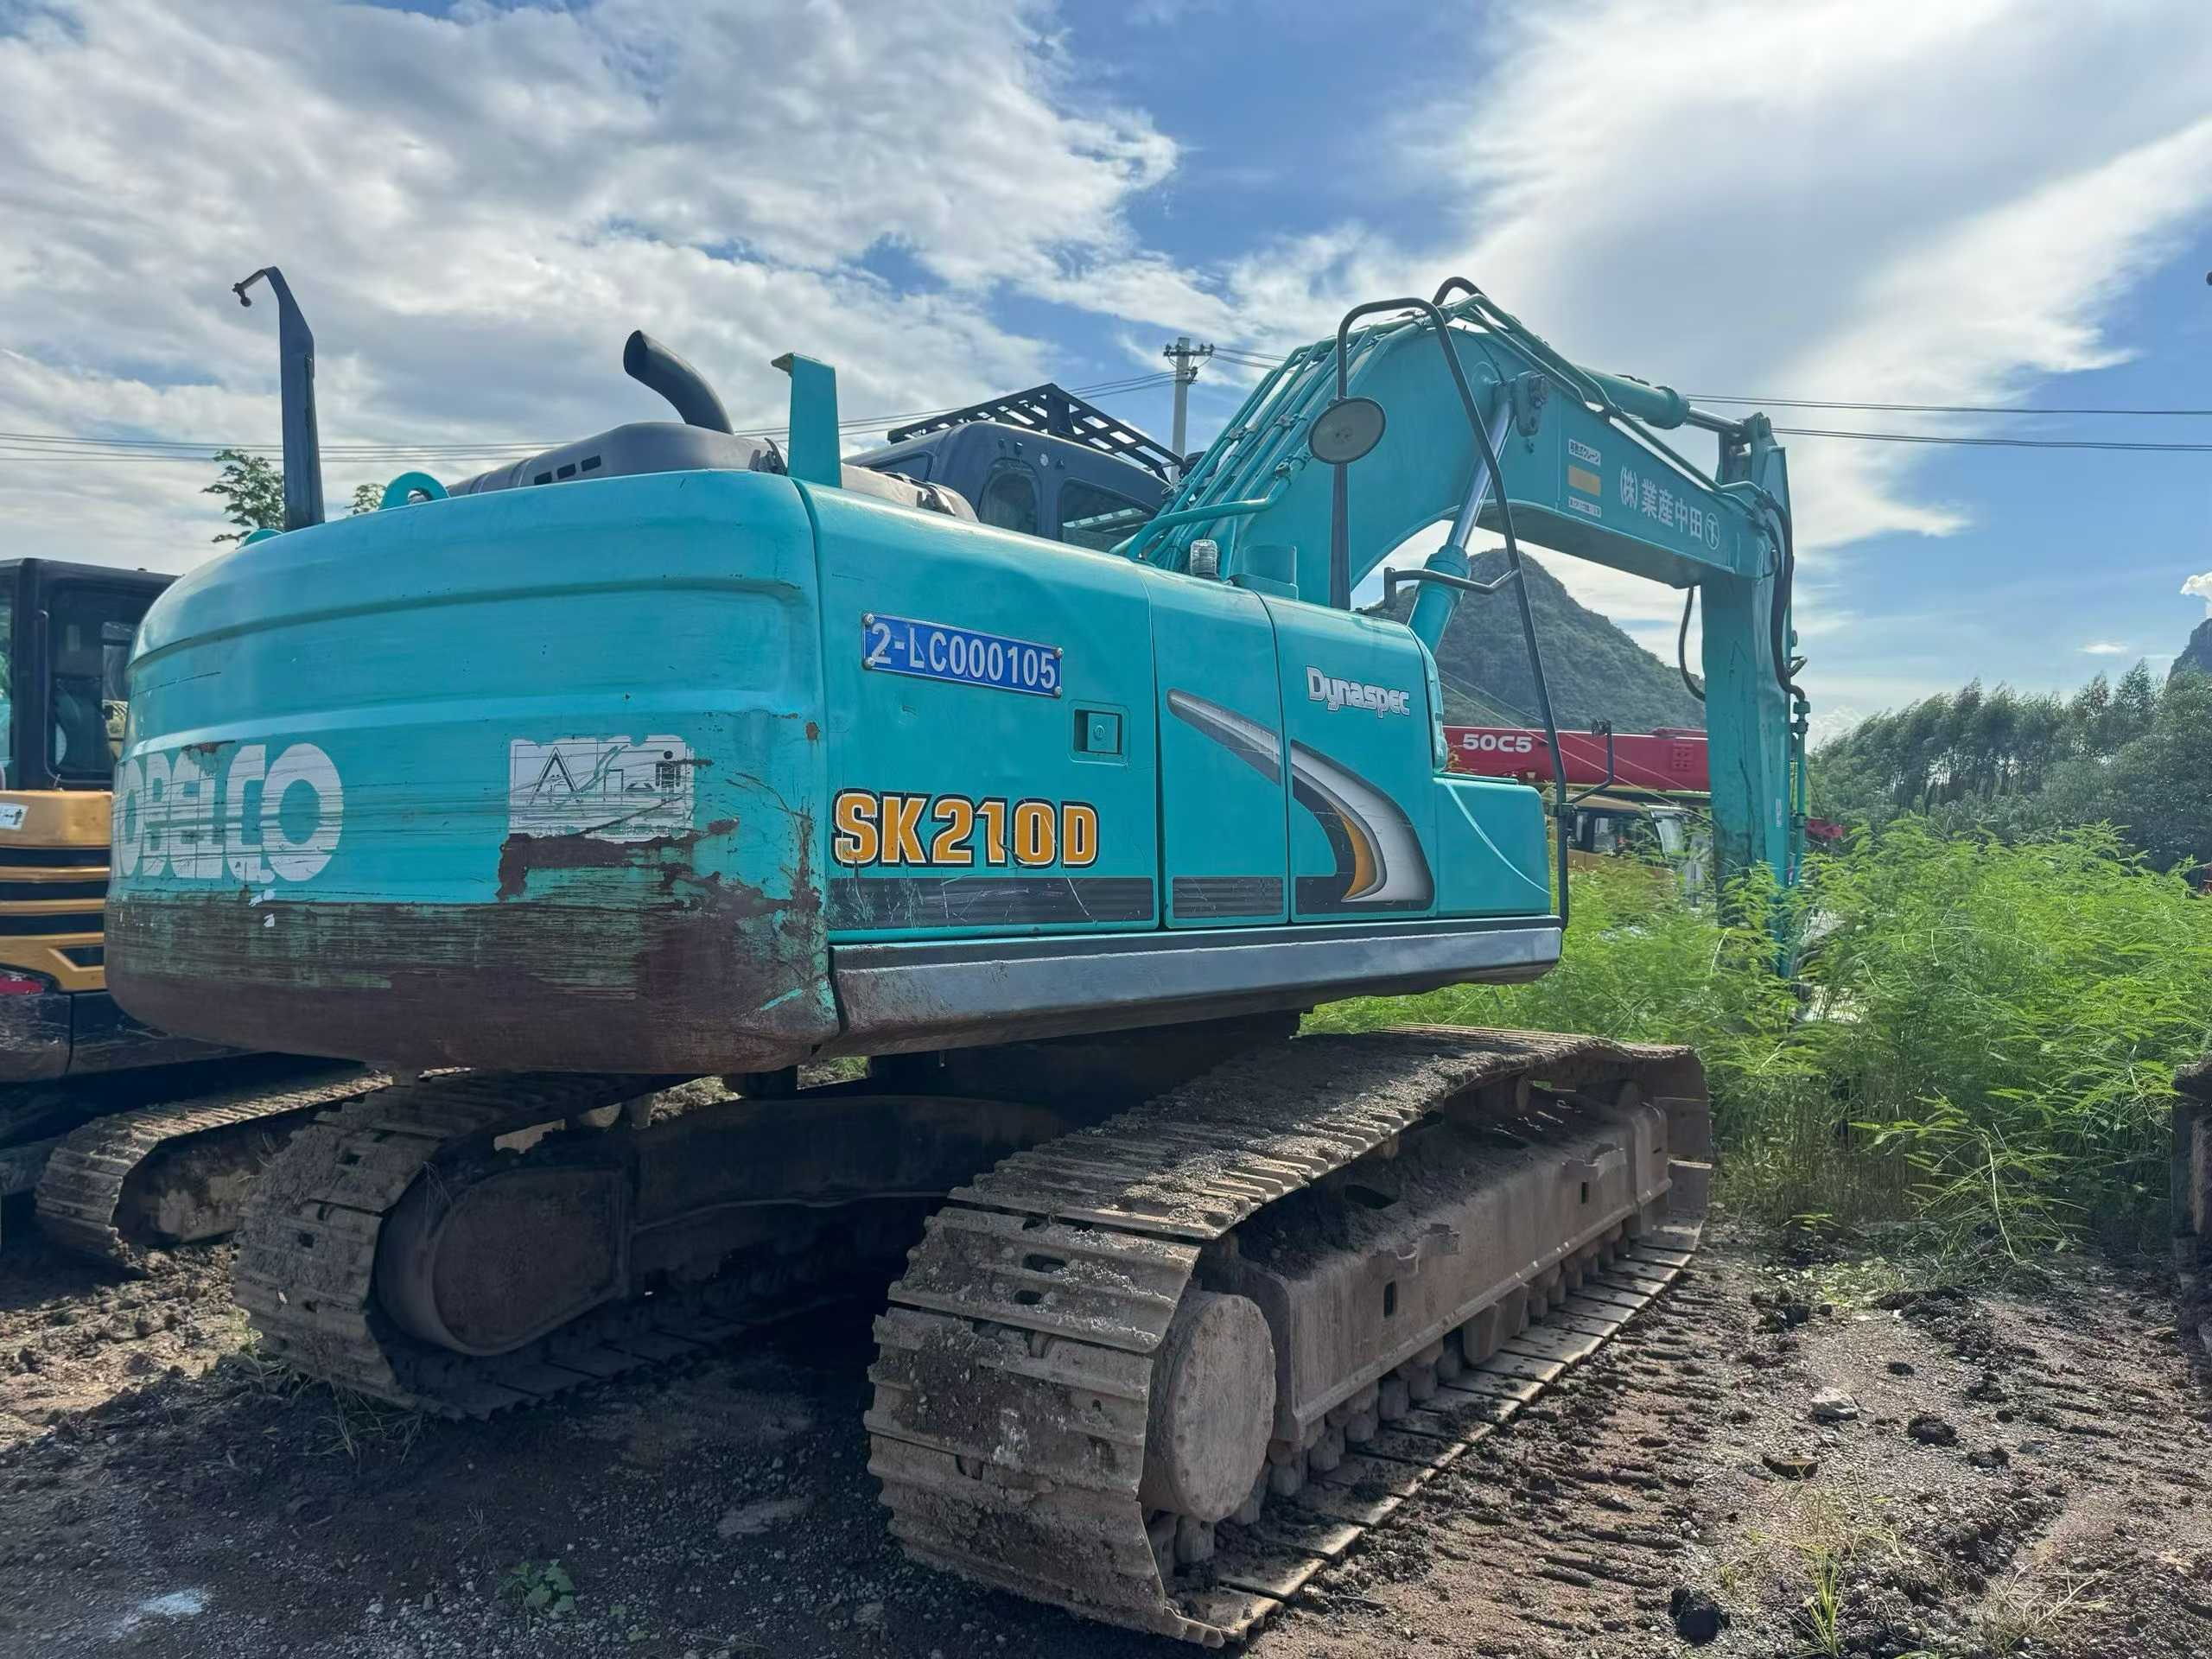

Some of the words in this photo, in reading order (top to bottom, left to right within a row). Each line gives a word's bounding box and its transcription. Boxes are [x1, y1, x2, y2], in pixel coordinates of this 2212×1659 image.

[871, 622, 1056, 690] 2-LC000105
[1306, 664, 1410, 718] Dynaspec
[1462, 734, 1533, 753] 50C5
[112, 743, 345, 884] OBELCO
[831, 788, 1099, 869] SK210D
